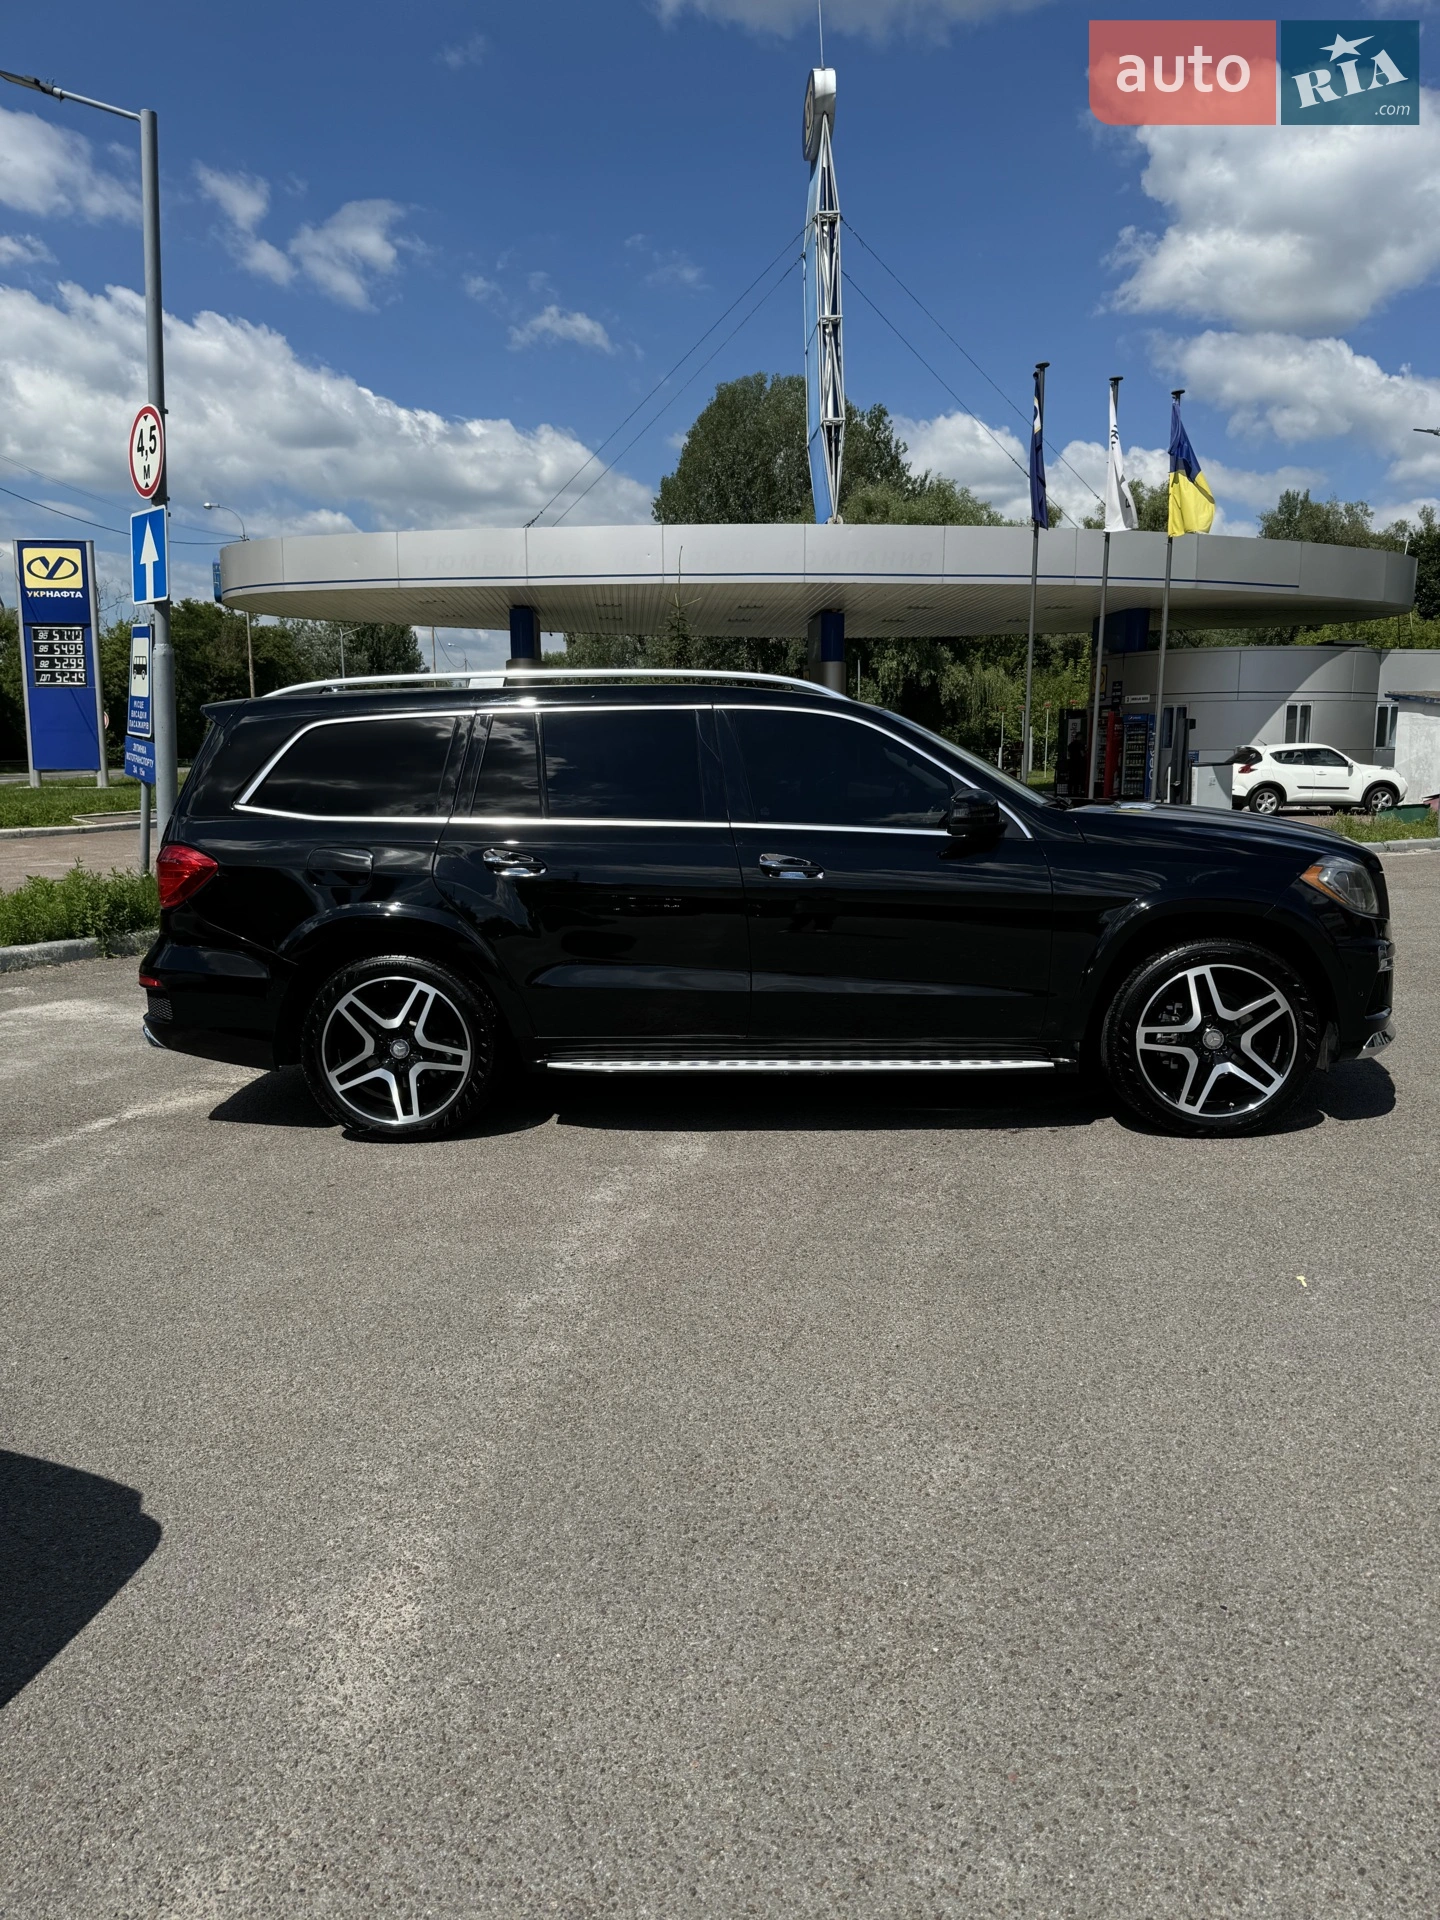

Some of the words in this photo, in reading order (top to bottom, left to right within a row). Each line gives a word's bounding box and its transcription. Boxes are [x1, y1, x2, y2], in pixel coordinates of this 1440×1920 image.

[137, 425, 157, 461] 4,5
[27, 590, 83, 598] УКРНАФТА
[38, 645, 49, 653] 95
[39, 660, 50, 668] 92
[40, 673, 51, 682] ДП
[131, 710, 147, 719] ВИСАДКИ
[129, 720, 149, 730] ПАСАЖИРІВ
